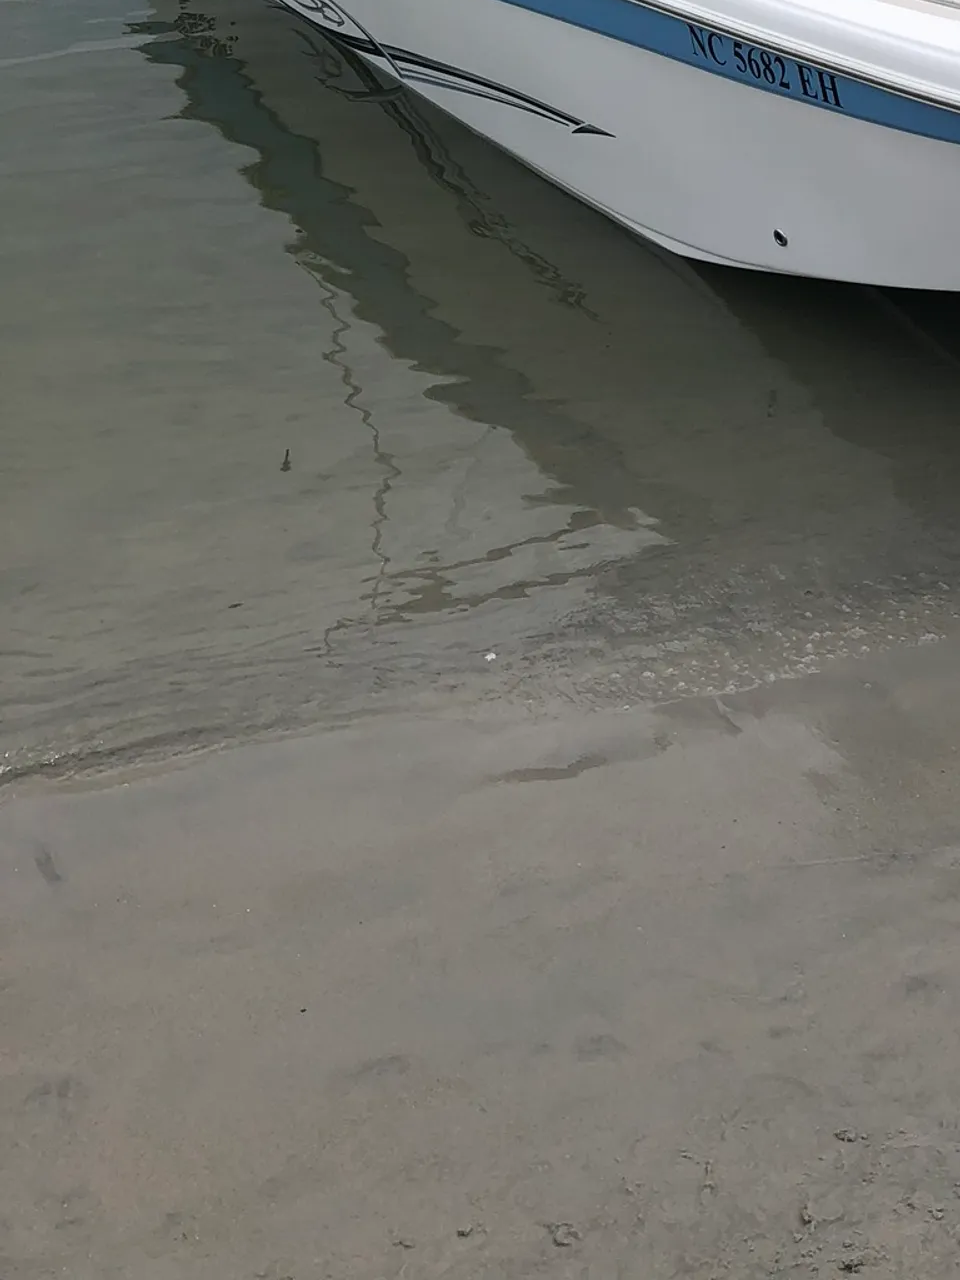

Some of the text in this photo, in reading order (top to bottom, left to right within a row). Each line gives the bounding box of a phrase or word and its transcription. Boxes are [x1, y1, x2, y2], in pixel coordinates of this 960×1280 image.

[686, 22, 844, 109] NC 5682 EH
